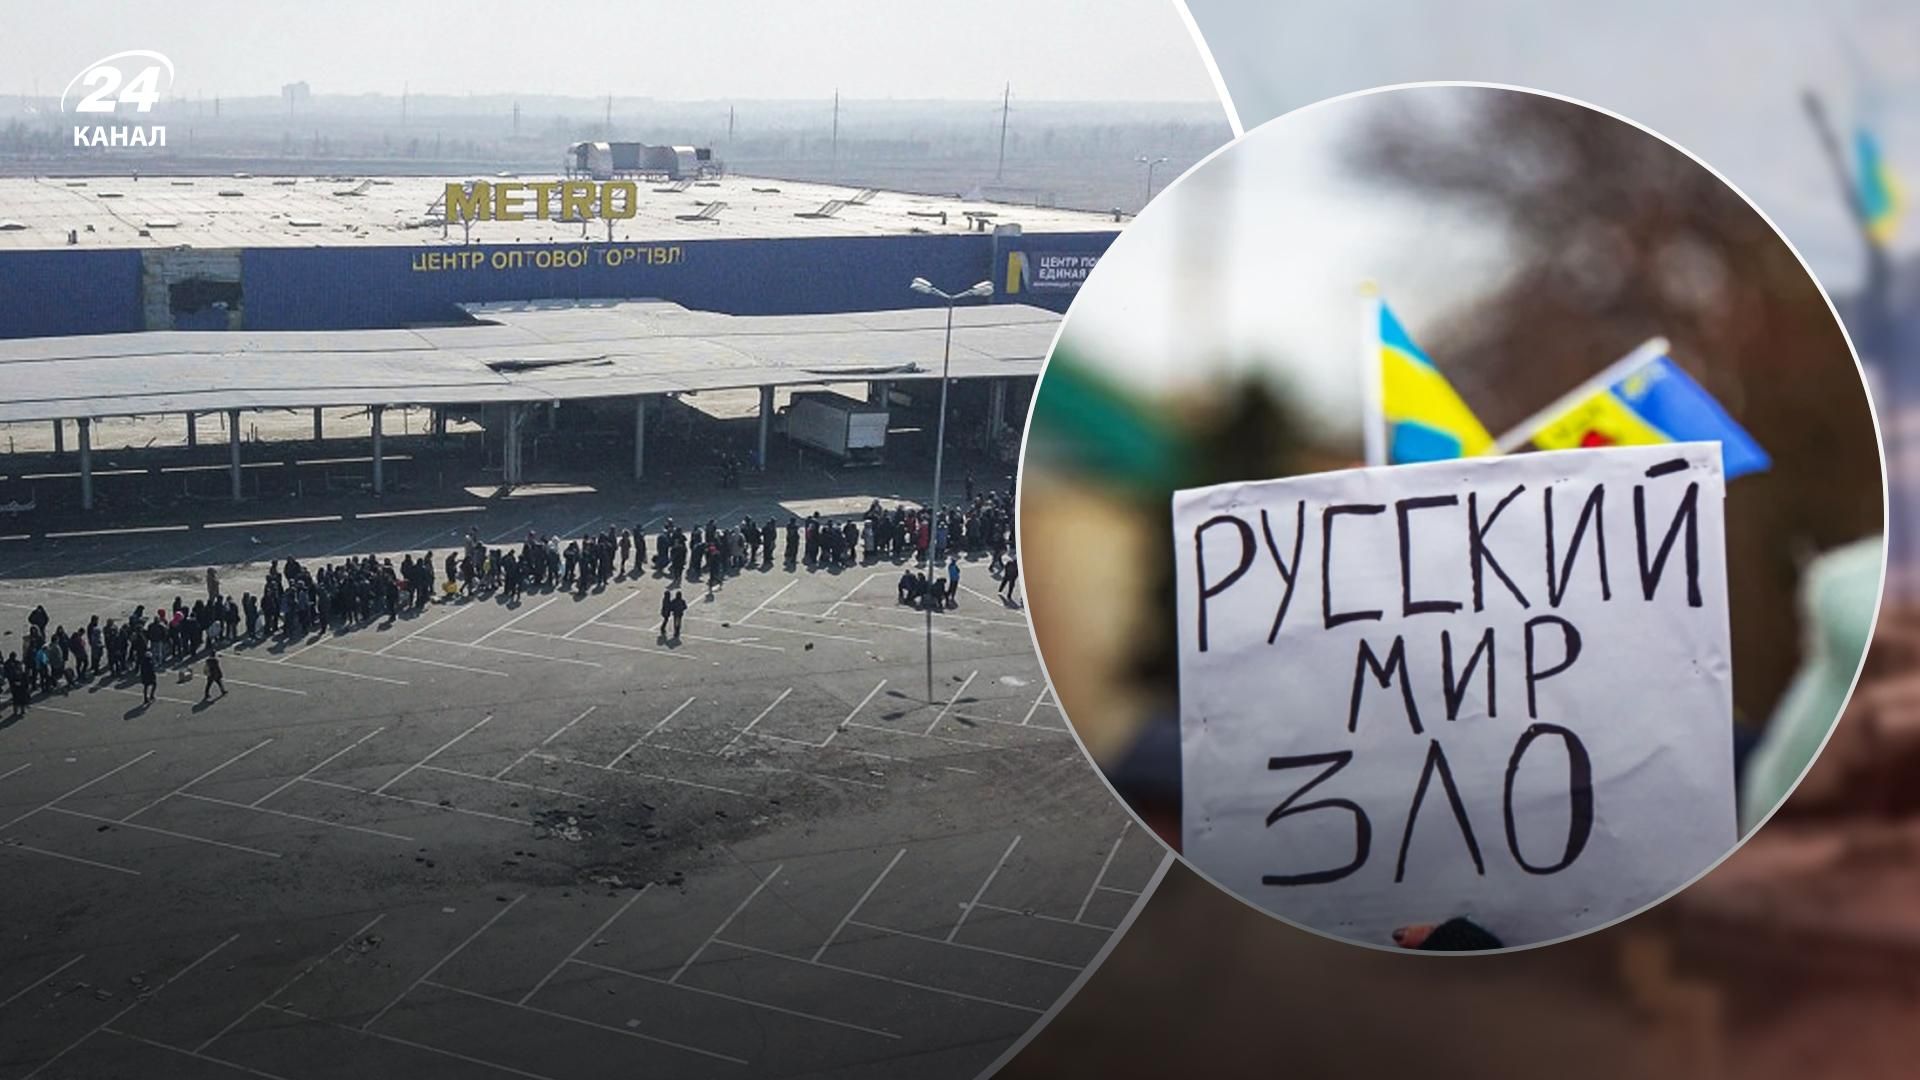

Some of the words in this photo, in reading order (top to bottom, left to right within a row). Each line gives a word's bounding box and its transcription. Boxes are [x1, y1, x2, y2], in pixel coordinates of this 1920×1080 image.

[445, 181, 638, 221] METRO
[412, 251, 485, 271] ЦЕНТР
[1039, 268, 1086, 280] ЕДИНАЯ
[1040, 256, 1078, 268] ЦЕНТР
[1080, 256, 1100, 267] ПО
[1195, 458, 1702, 652] РУССКИЙ
[1348, 615, 1582, 735] МИР
[1262, 723, 1594, 886] ЗЛО
